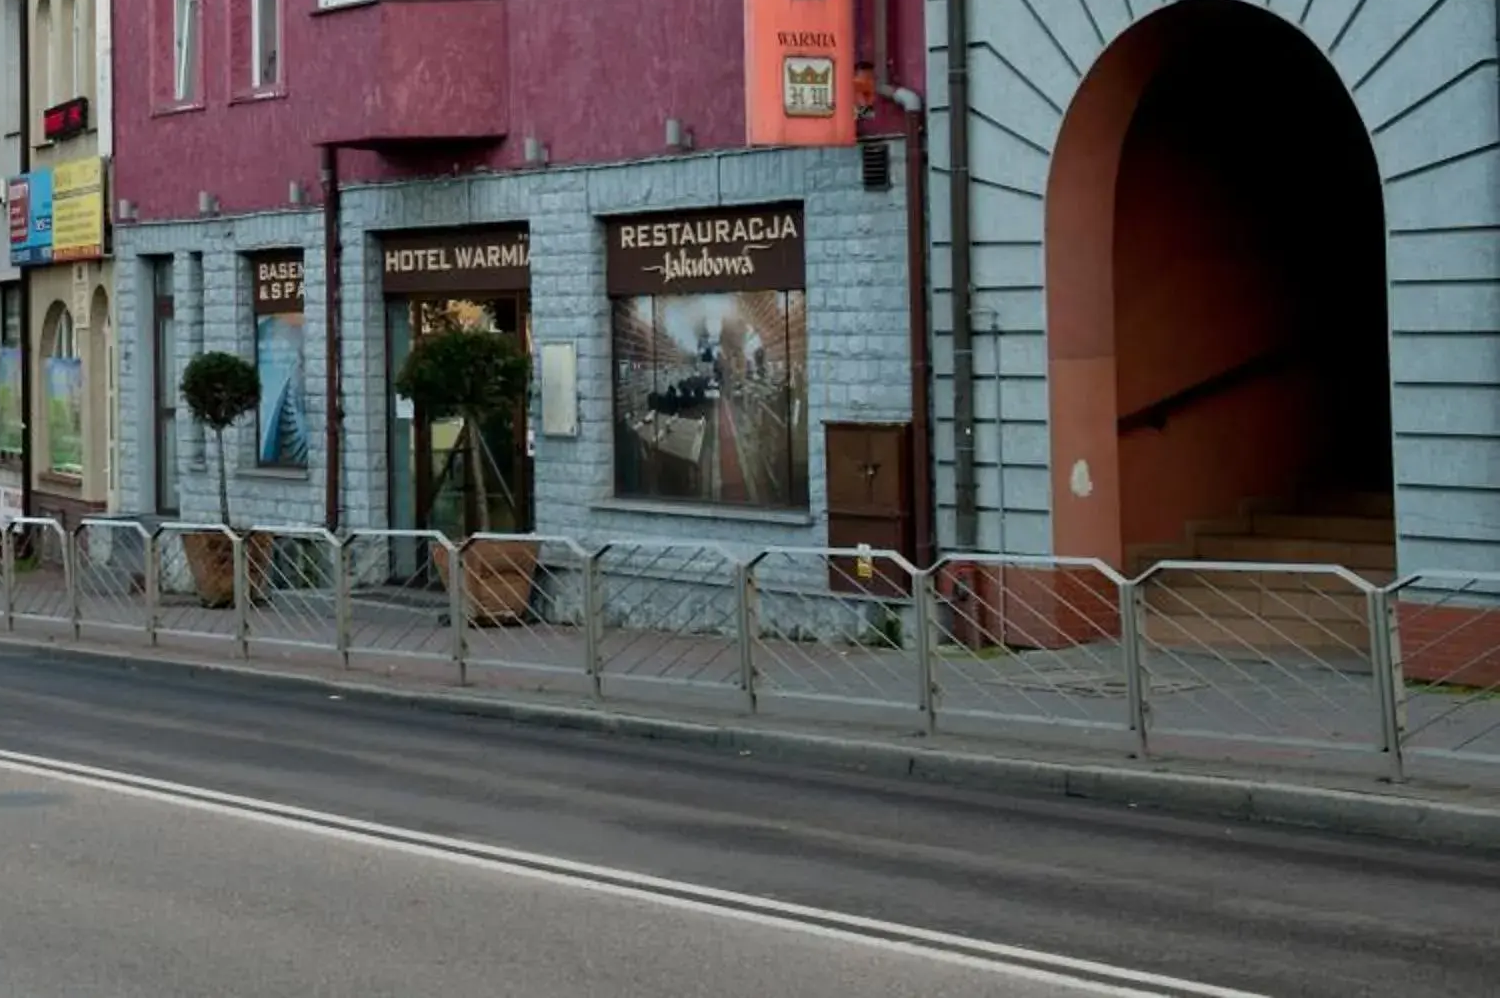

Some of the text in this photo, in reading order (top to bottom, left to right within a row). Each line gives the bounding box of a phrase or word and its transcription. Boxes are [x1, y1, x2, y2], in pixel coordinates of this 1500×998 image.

[777, 31, 837, 47] WARMIA
[620, 214, 798, 249] RESTAURACJA
[384, 247, 451, 273] HOTEL
[648, 245, 760, 284] Jakubowa
